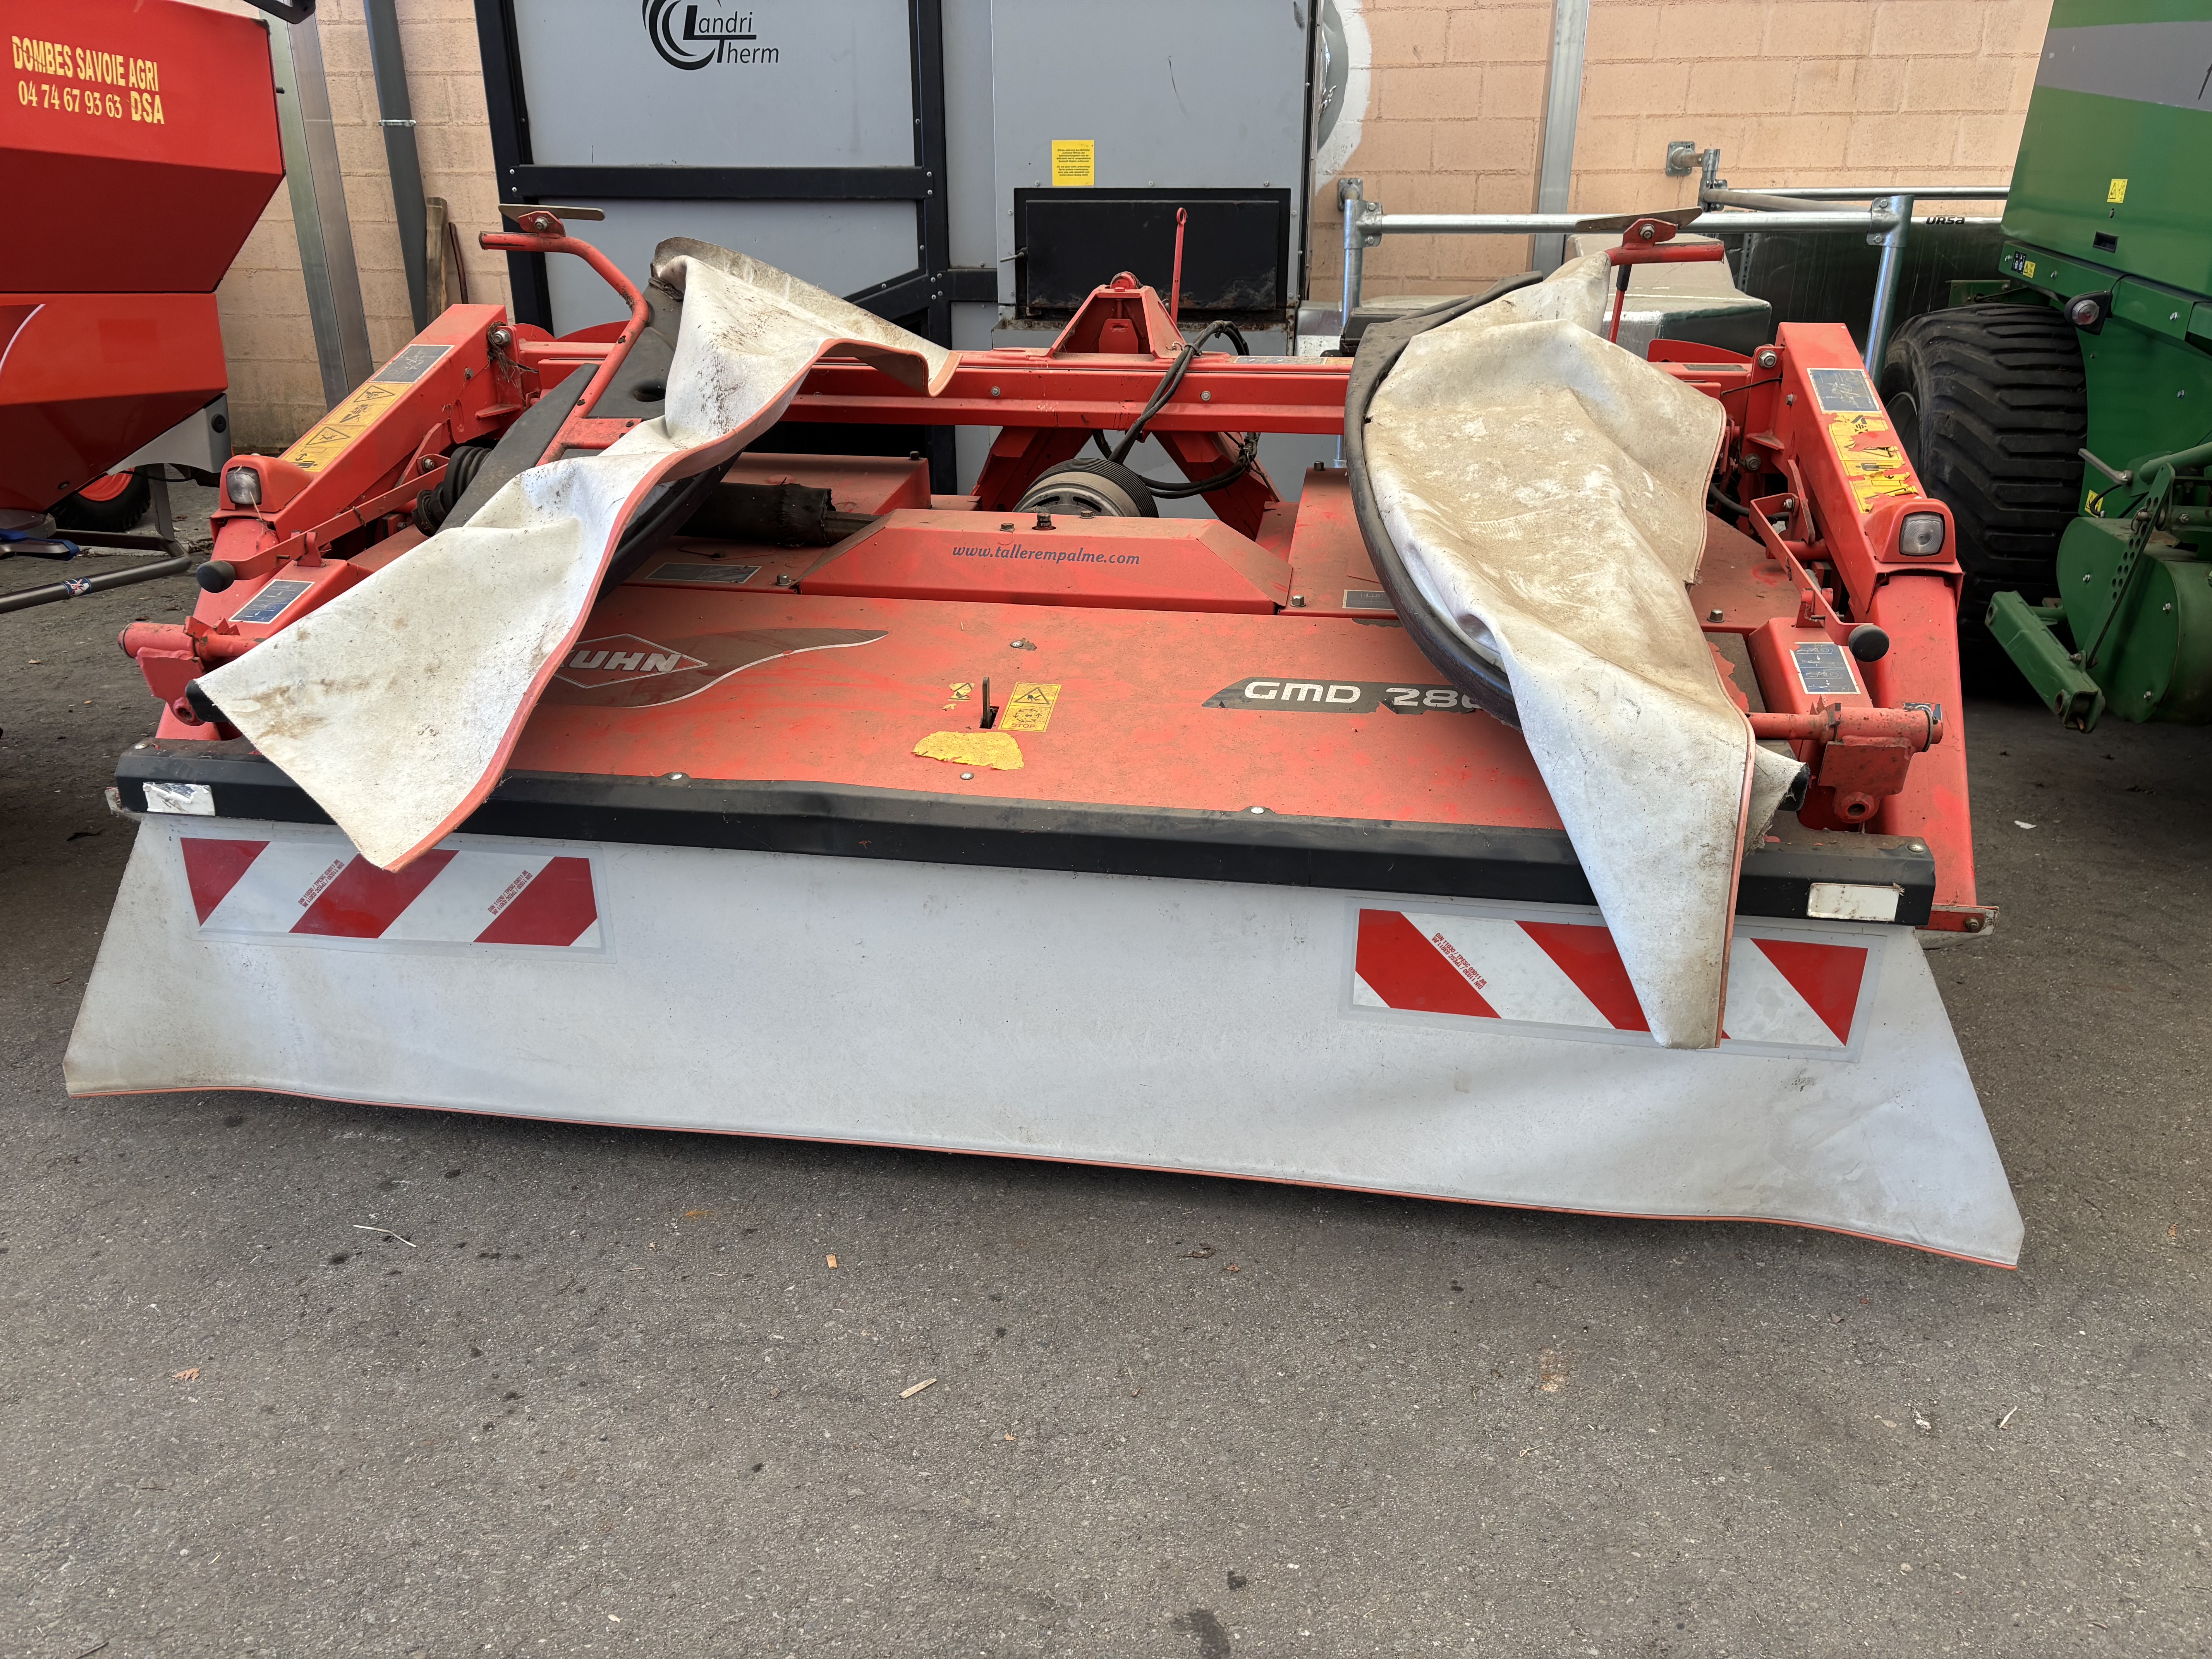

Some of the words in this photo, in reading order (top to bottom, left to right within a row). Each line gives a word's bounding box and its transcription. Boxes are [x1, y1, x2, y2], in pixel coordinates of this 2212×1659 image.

[683, 5, 756, 40] Landri
[12, 36, 73, 78] DOMBES
[76, 47, 126, 86] SAVOIE
[129, 57, 159, 92] AGRI
[717, 36, 779, 64] Therm
[19, 80, 38, 106] 04
[41, 84, 60, 110] 74
[64, 88, 80, 112] 67
[85, 91, 102, 115] 93
[106, 94, 122, 118] 63
[131, 91, 165, 125] DSA
[953, 544, 1140, 565] www.tallerempalme.com
[560, 650, 683, 673] UHN
[1245, 681, 1361, 703] GMD
